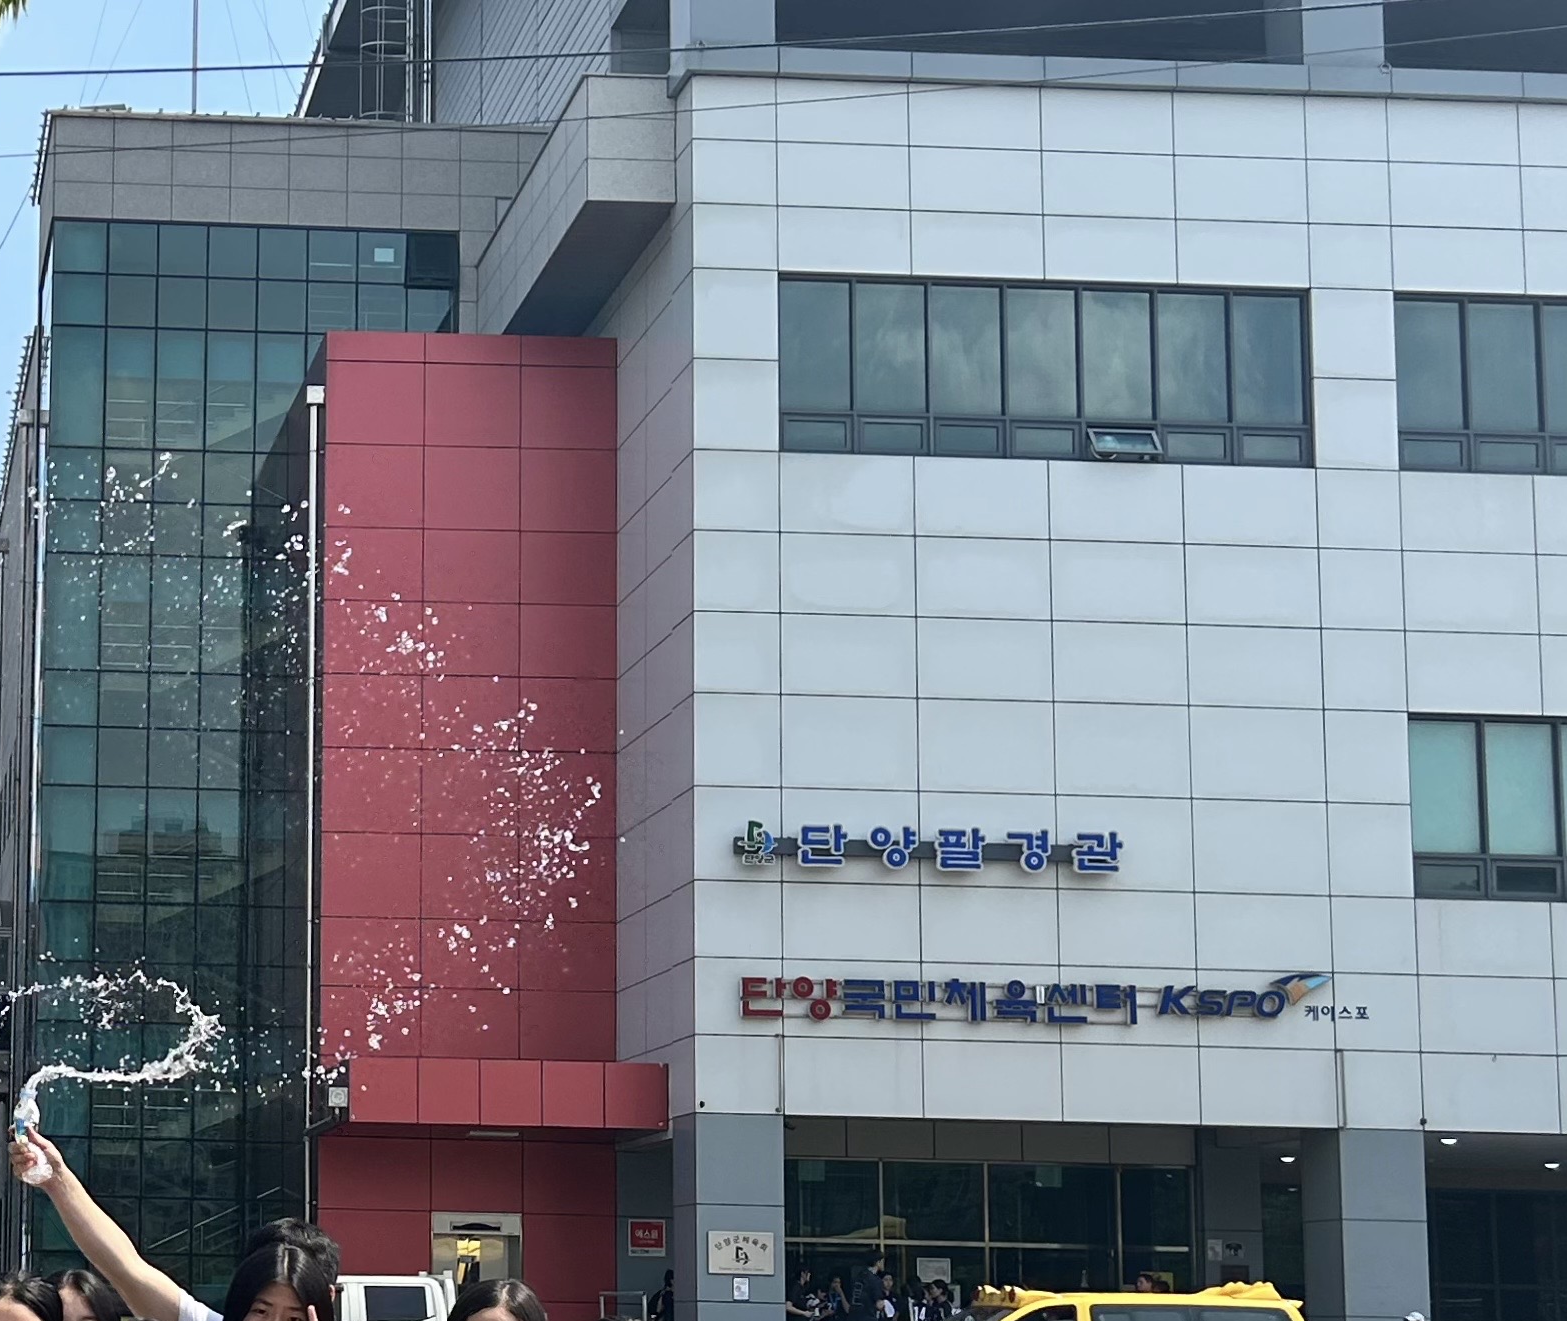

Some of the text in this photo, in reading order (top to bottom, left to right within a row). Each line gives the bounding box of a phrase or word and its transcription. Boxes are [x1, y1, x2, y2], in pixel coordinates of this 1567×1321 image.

[798, 823, 1124, 873] 단양팔경관
[740, 976, 1138, 1025] 단양국민체육센터
[1156, 984, 1286, 1018] KSPO
[1304, 1005, 1370, 1021] 케이스포
[714, 1235, 769, 1252] 단양군체육회
[913, 1306, 926, 1321] 14
